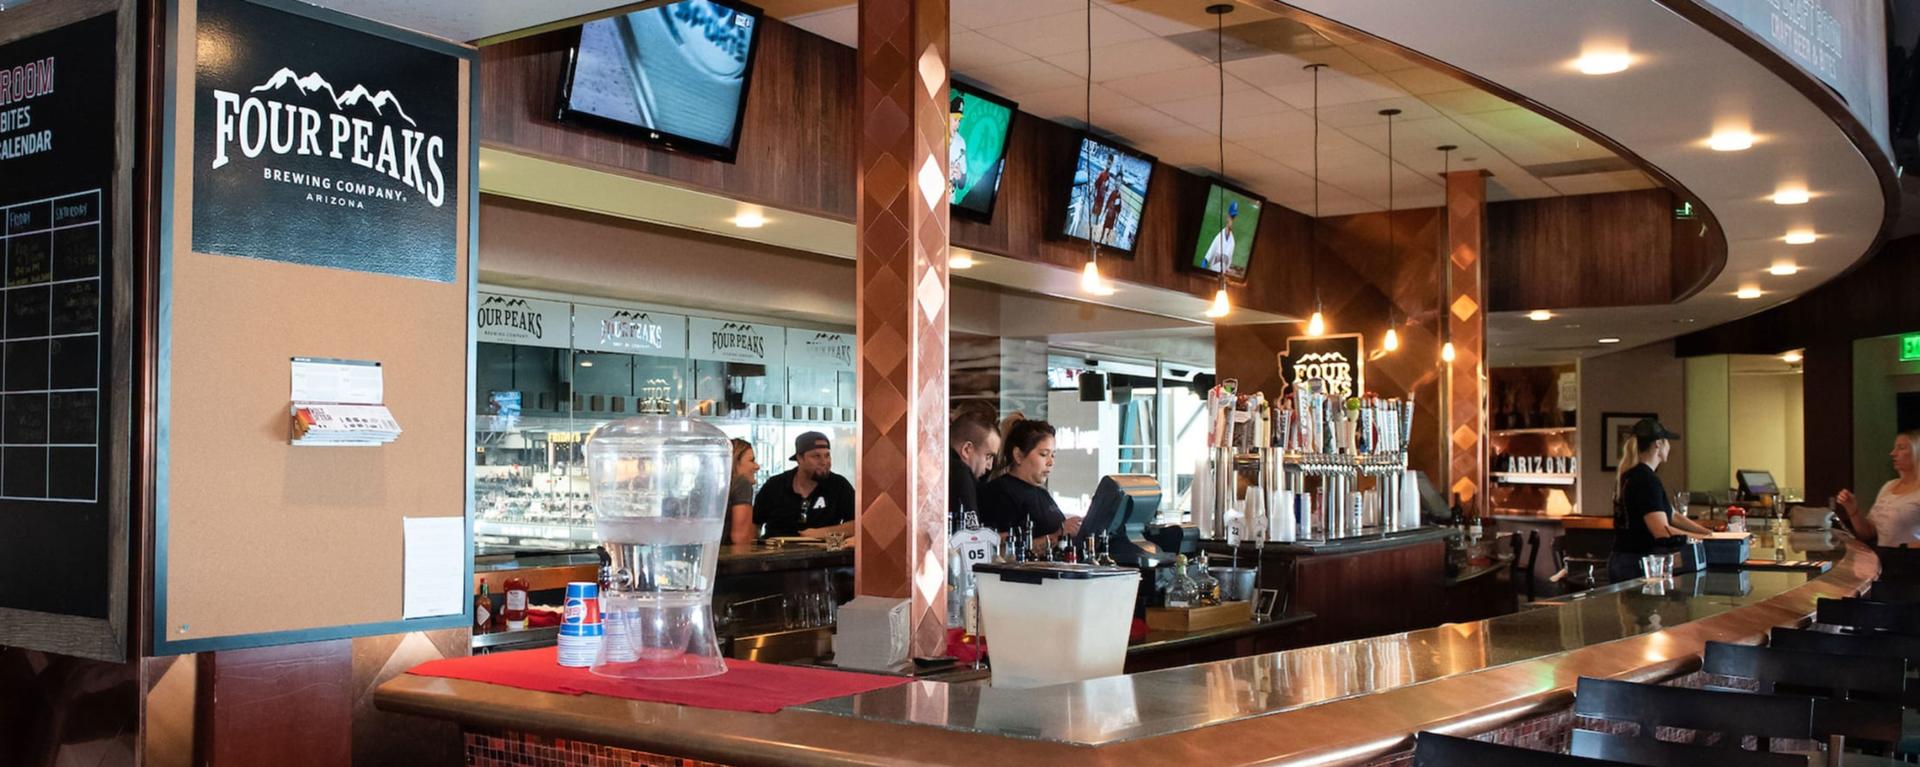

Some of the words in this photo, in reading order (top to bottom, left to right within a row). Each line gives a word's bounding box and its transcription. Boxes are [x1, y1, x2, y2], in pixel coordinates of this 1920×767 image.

[0, 56, 54, 105] ROOM
[0, 106, 31, 133] BITES
[0, 130, 52, 160] ALENDAR
[212, 89, 322, 170] FOUR
[329, 113, 444, 207] PEAKS
[264, 168, 331, 190] BREWING
[306, 193, 364, 209] ARIZONA
[478, 308, 502, 328] OUR
[504, 310, 542, 340] PEAKS
[712, 331, 735, 354] FOUR
[736, 334, 764, 359] PEAKS
[1293, 363, 1352, 384] FOUR
[1508, 456, 1576, 474] ARIZONA
[1231, 526, 1239, 536] 22
[968, 549, 985, 560] 05
